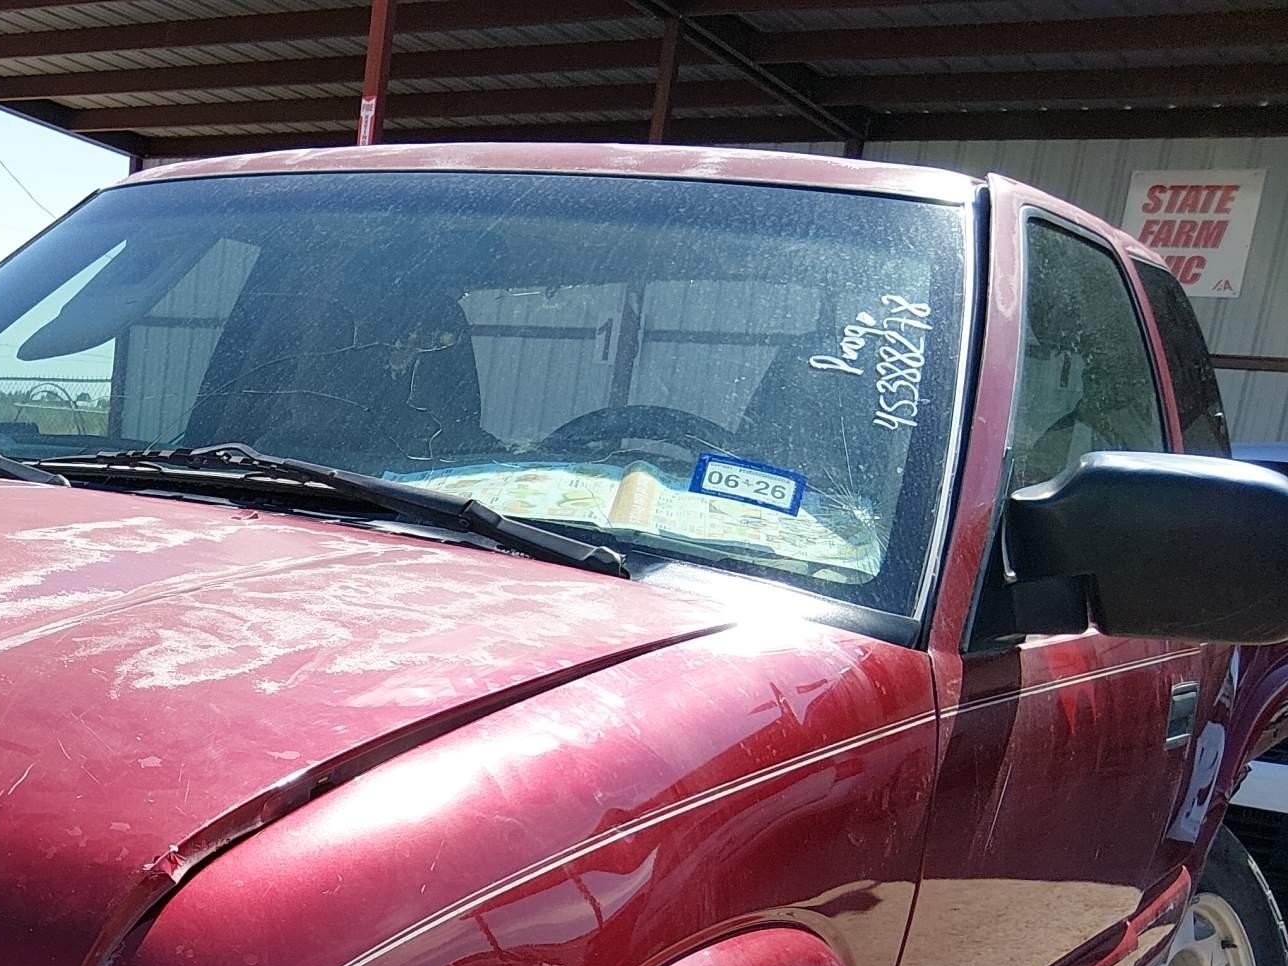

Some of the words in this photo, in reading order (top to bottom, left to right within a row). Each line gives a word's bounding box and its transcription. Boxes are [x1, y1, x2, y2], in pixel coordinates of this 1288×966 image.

[1142, 184, 1241, 214] STATE
[1137, 219, 1230, 249] FARM
[872, 294, 933, 430] 45388278
[707, 470, 741, 489] 06
[753, 480, 787, 500] 26
